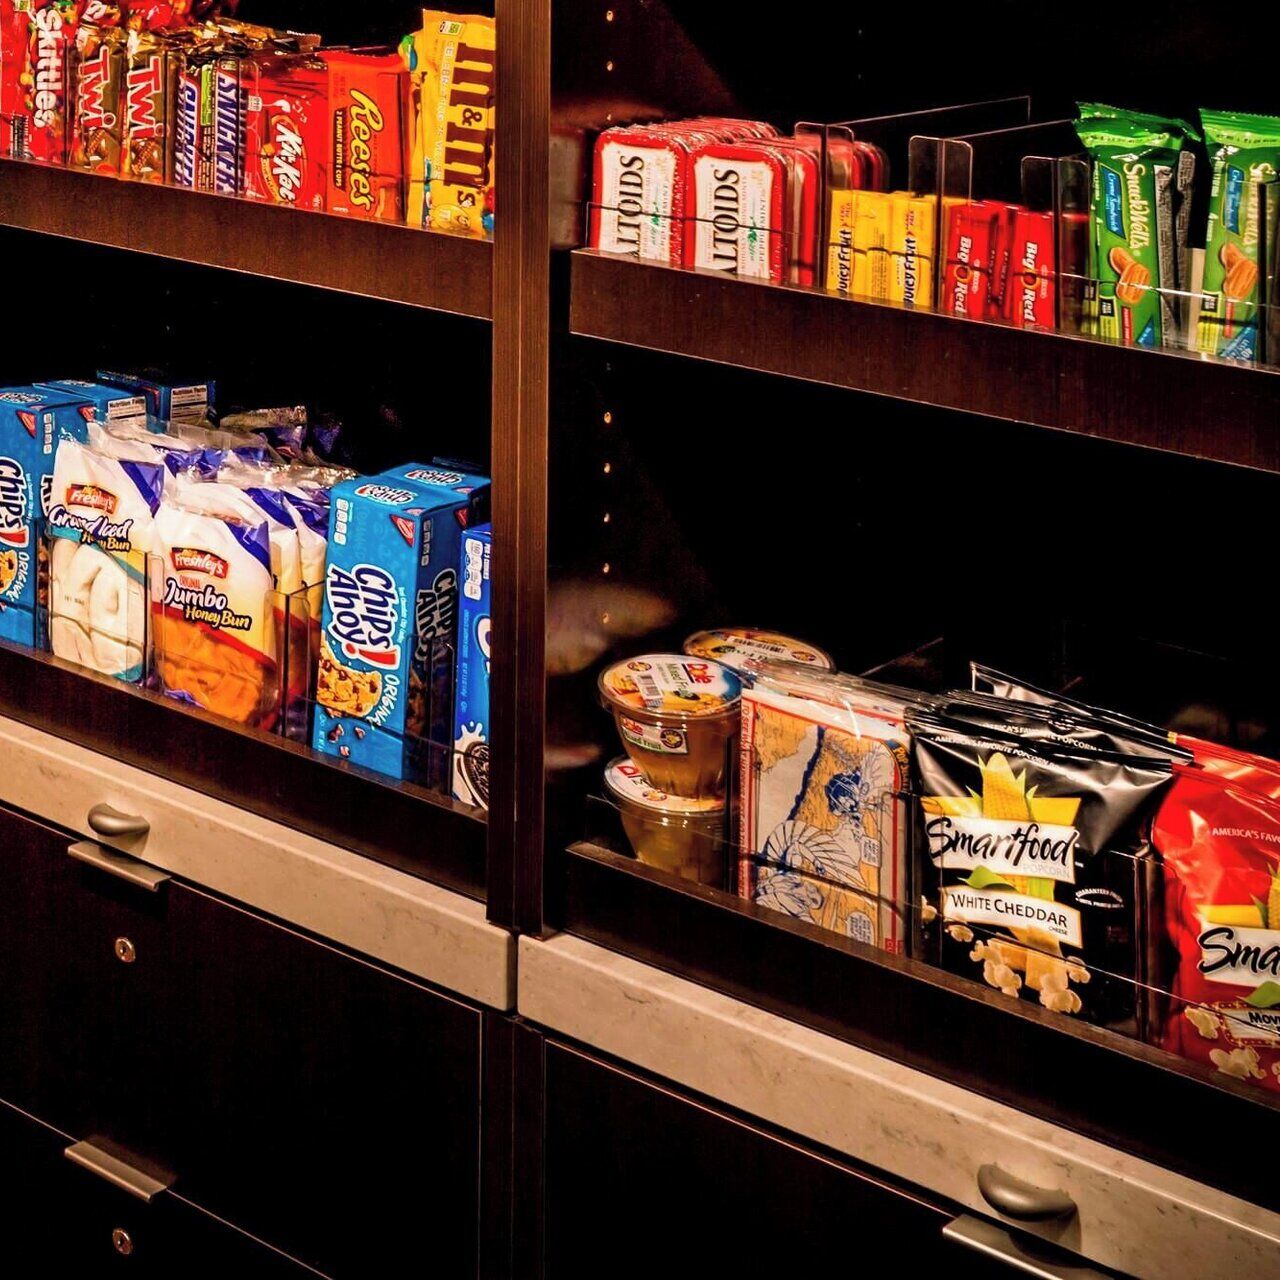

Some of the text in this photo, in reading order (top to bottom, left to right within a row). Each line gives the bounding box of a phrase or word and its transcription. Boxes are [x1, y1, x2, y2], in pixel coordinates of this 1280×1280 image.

[34, 8, 63, 128] Skittles
[349, 88, 384, 211] Reese's
[955, 235, 972, 314] Big Red
[1021, 241, 1038, 322] Big Red
[99, 516, 135, 541] Iced
[107, 539, 131, 552] Bun
[175, 552, 225, 576] Freshley's
[165, 578, 227, 610] Jumbo
[354, 566, 397, 650] Chips
[185, 603, 250, 629] Honey Bun
[926, 817, 1080, 867] Smartfood
[1211, 826, 1260, 841] AMERICA'S
[952, 893, 1069, 928] WHITE CHEDDAR
